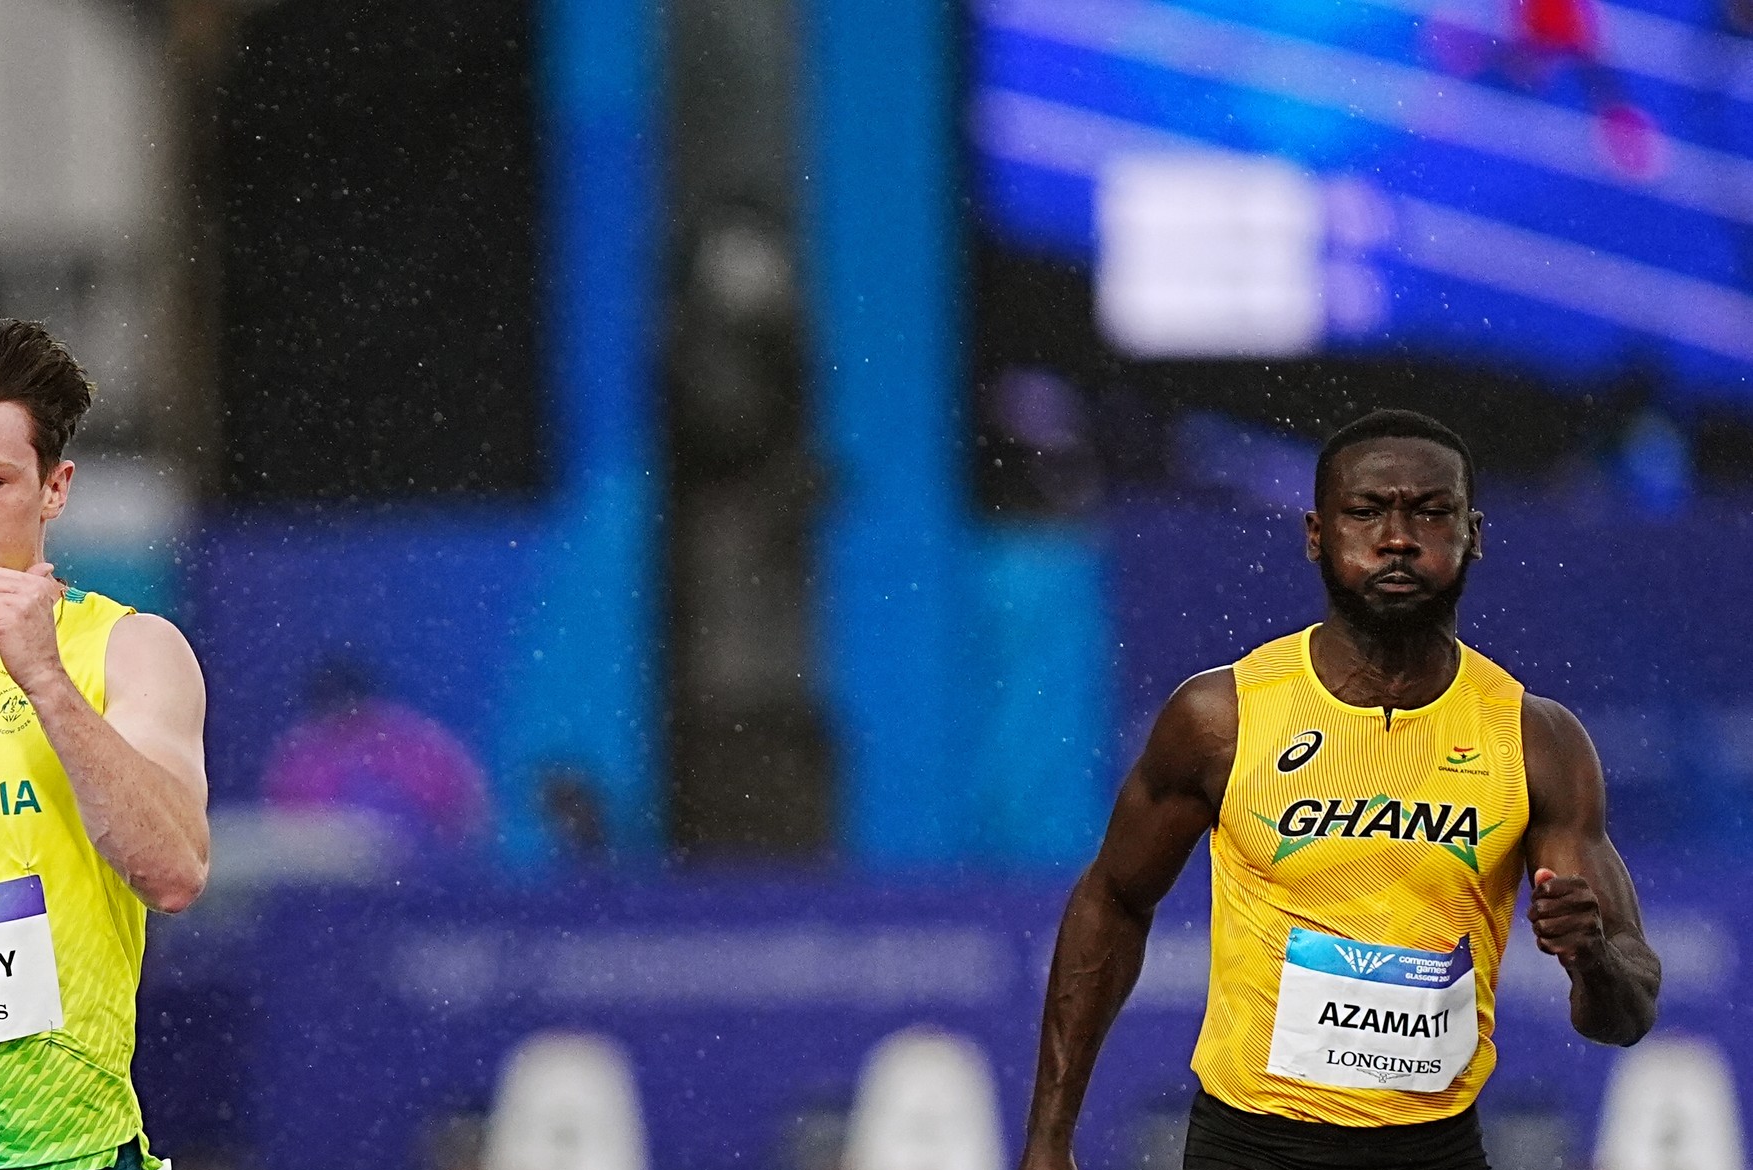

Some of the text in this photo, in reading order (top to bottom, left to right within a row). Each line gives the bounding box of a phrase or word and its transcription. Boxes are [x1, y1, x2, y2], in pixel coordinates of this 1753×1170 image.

[1277, 799, 1479, 846] GHANA
[1405, 972, 1439, 983] GLASGOW
[1416, 965, 1447, 975] games
[1317, 1001, 1449, 1038] AZAMATI
[1326, 1049, 1442, 1074] LONGINES
